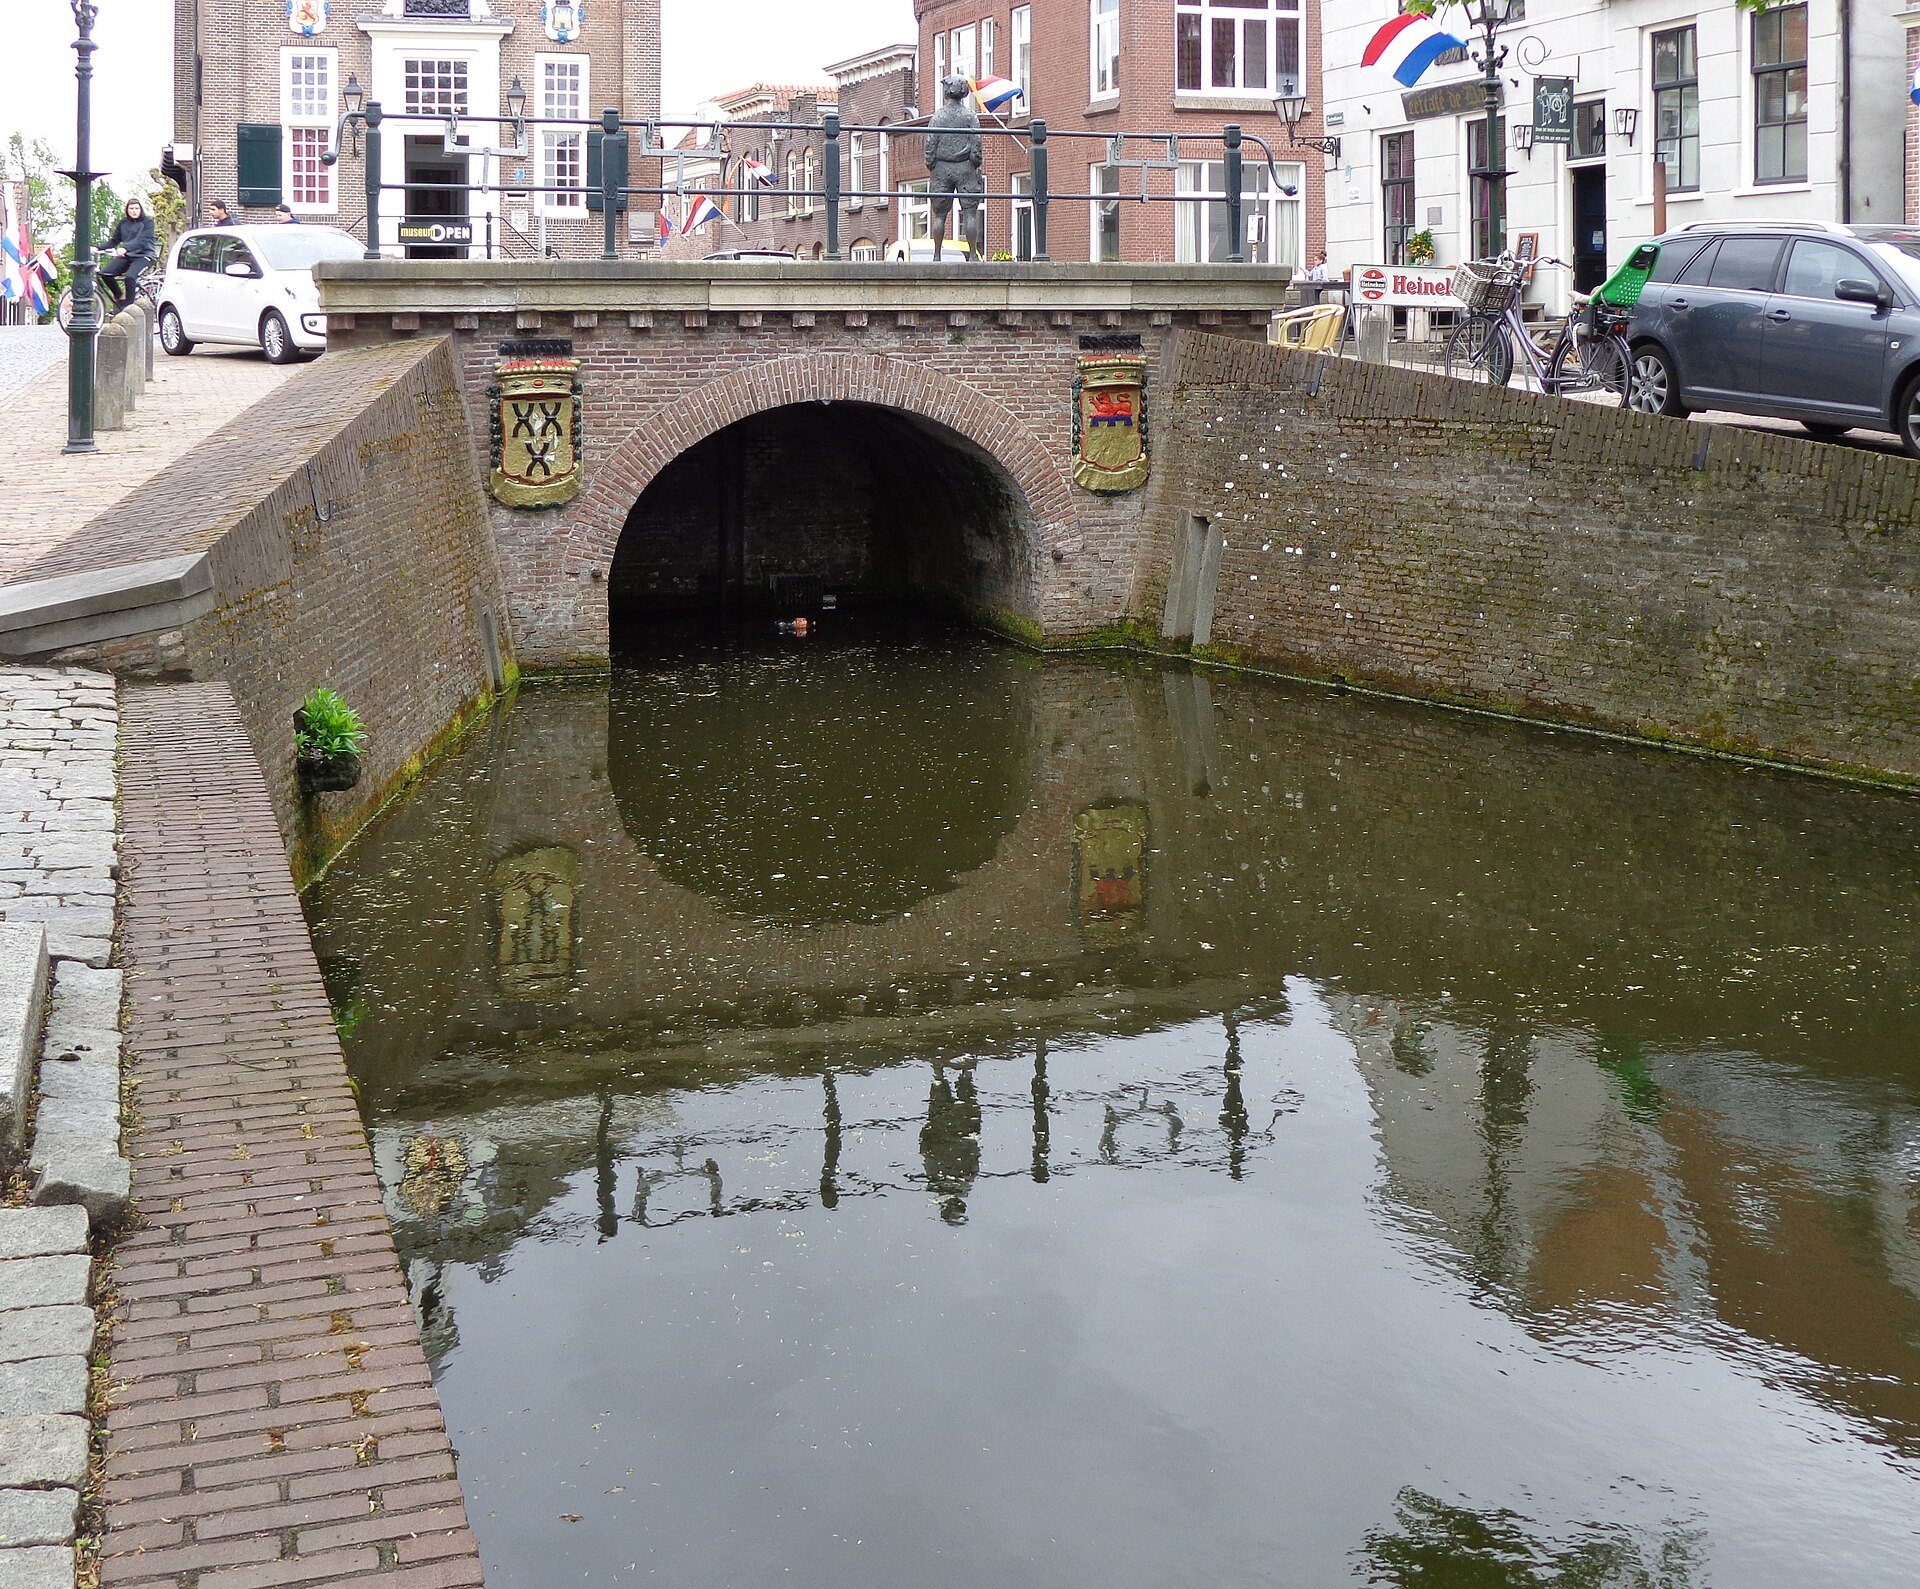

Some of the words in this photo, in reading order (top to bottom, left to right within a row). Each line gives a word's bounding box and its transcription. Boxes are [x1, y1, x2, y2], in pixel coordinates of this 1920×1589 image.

[400, 227, 435, 237] museum
[430, 224, 470, 242] OPEN
[1392, 275, 1453, 296] Heinek
